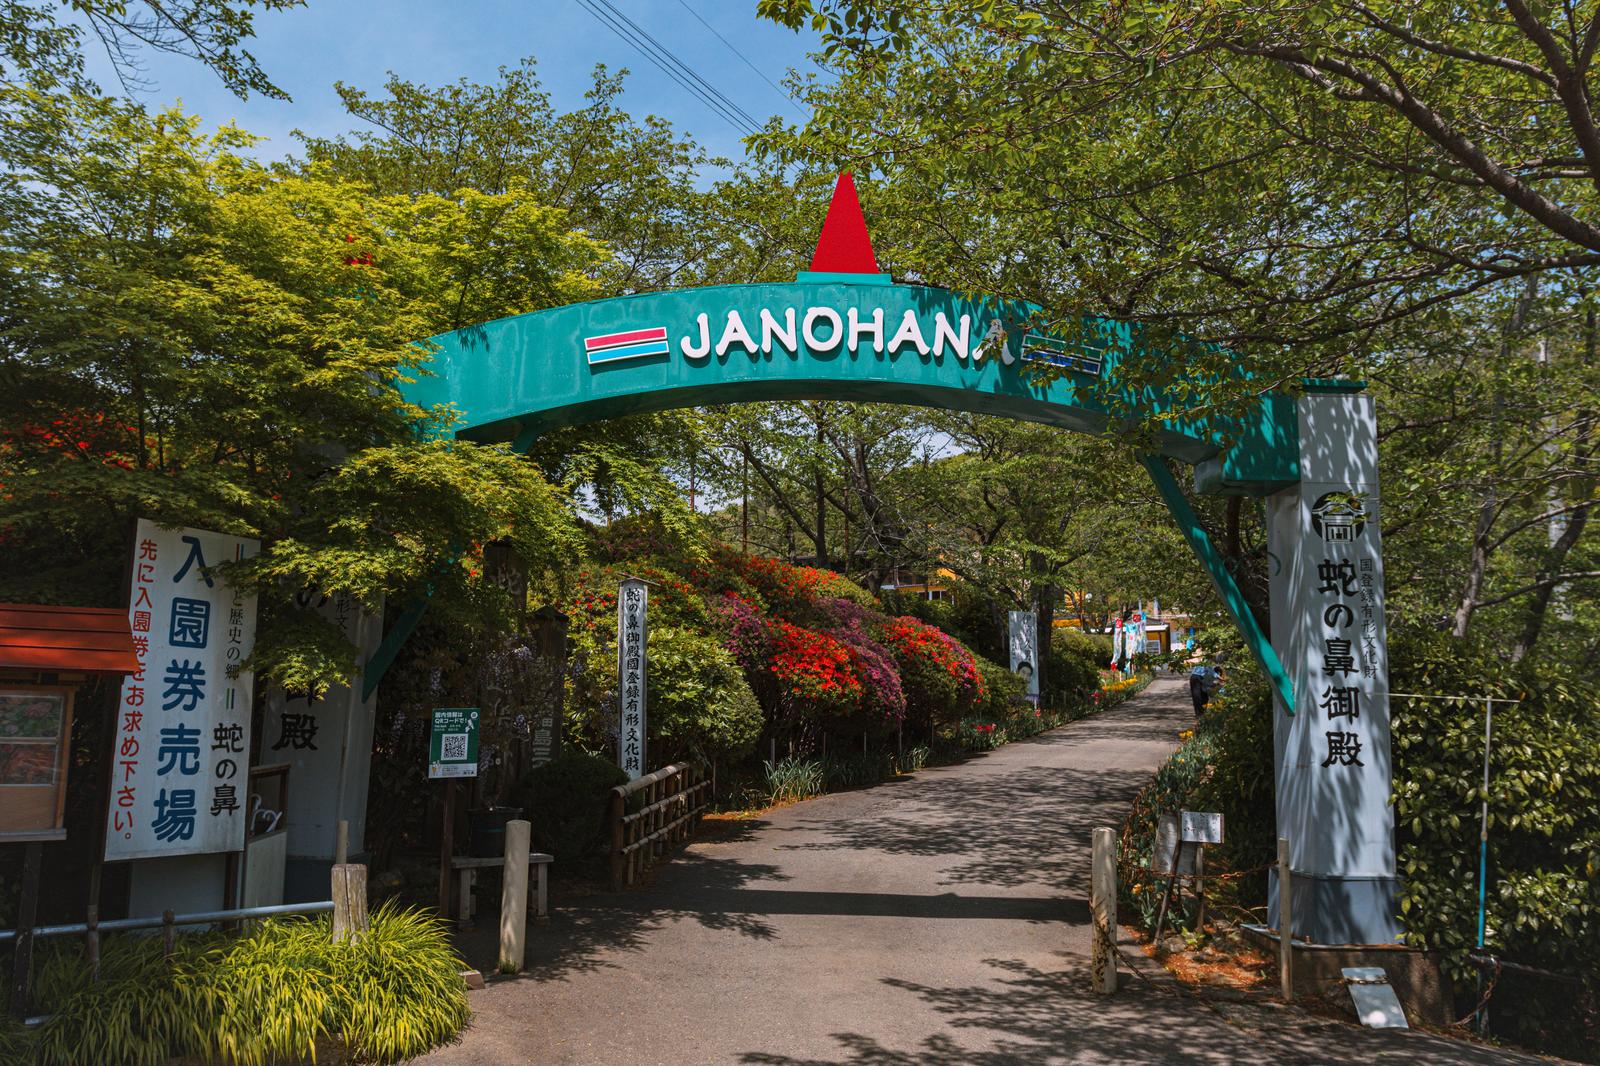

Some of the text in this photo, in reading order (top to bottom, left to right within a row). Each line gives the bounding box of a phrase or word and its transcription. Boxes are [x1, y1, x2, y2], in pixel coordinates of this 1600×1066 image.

[680, 307, 1016, 366] JANOHANA
[114, 538, 158, 840] 先に入園券をお求め下さい。
[151, 535, 214, 843] 入園券売場
[210, 582, 244, 817] と歴史の郷 蛇の鼻
[1316, 558, 1365, 769] 蛇の鼻御殿
[1359, 558, 1378, 680] 国登録有形文化財
